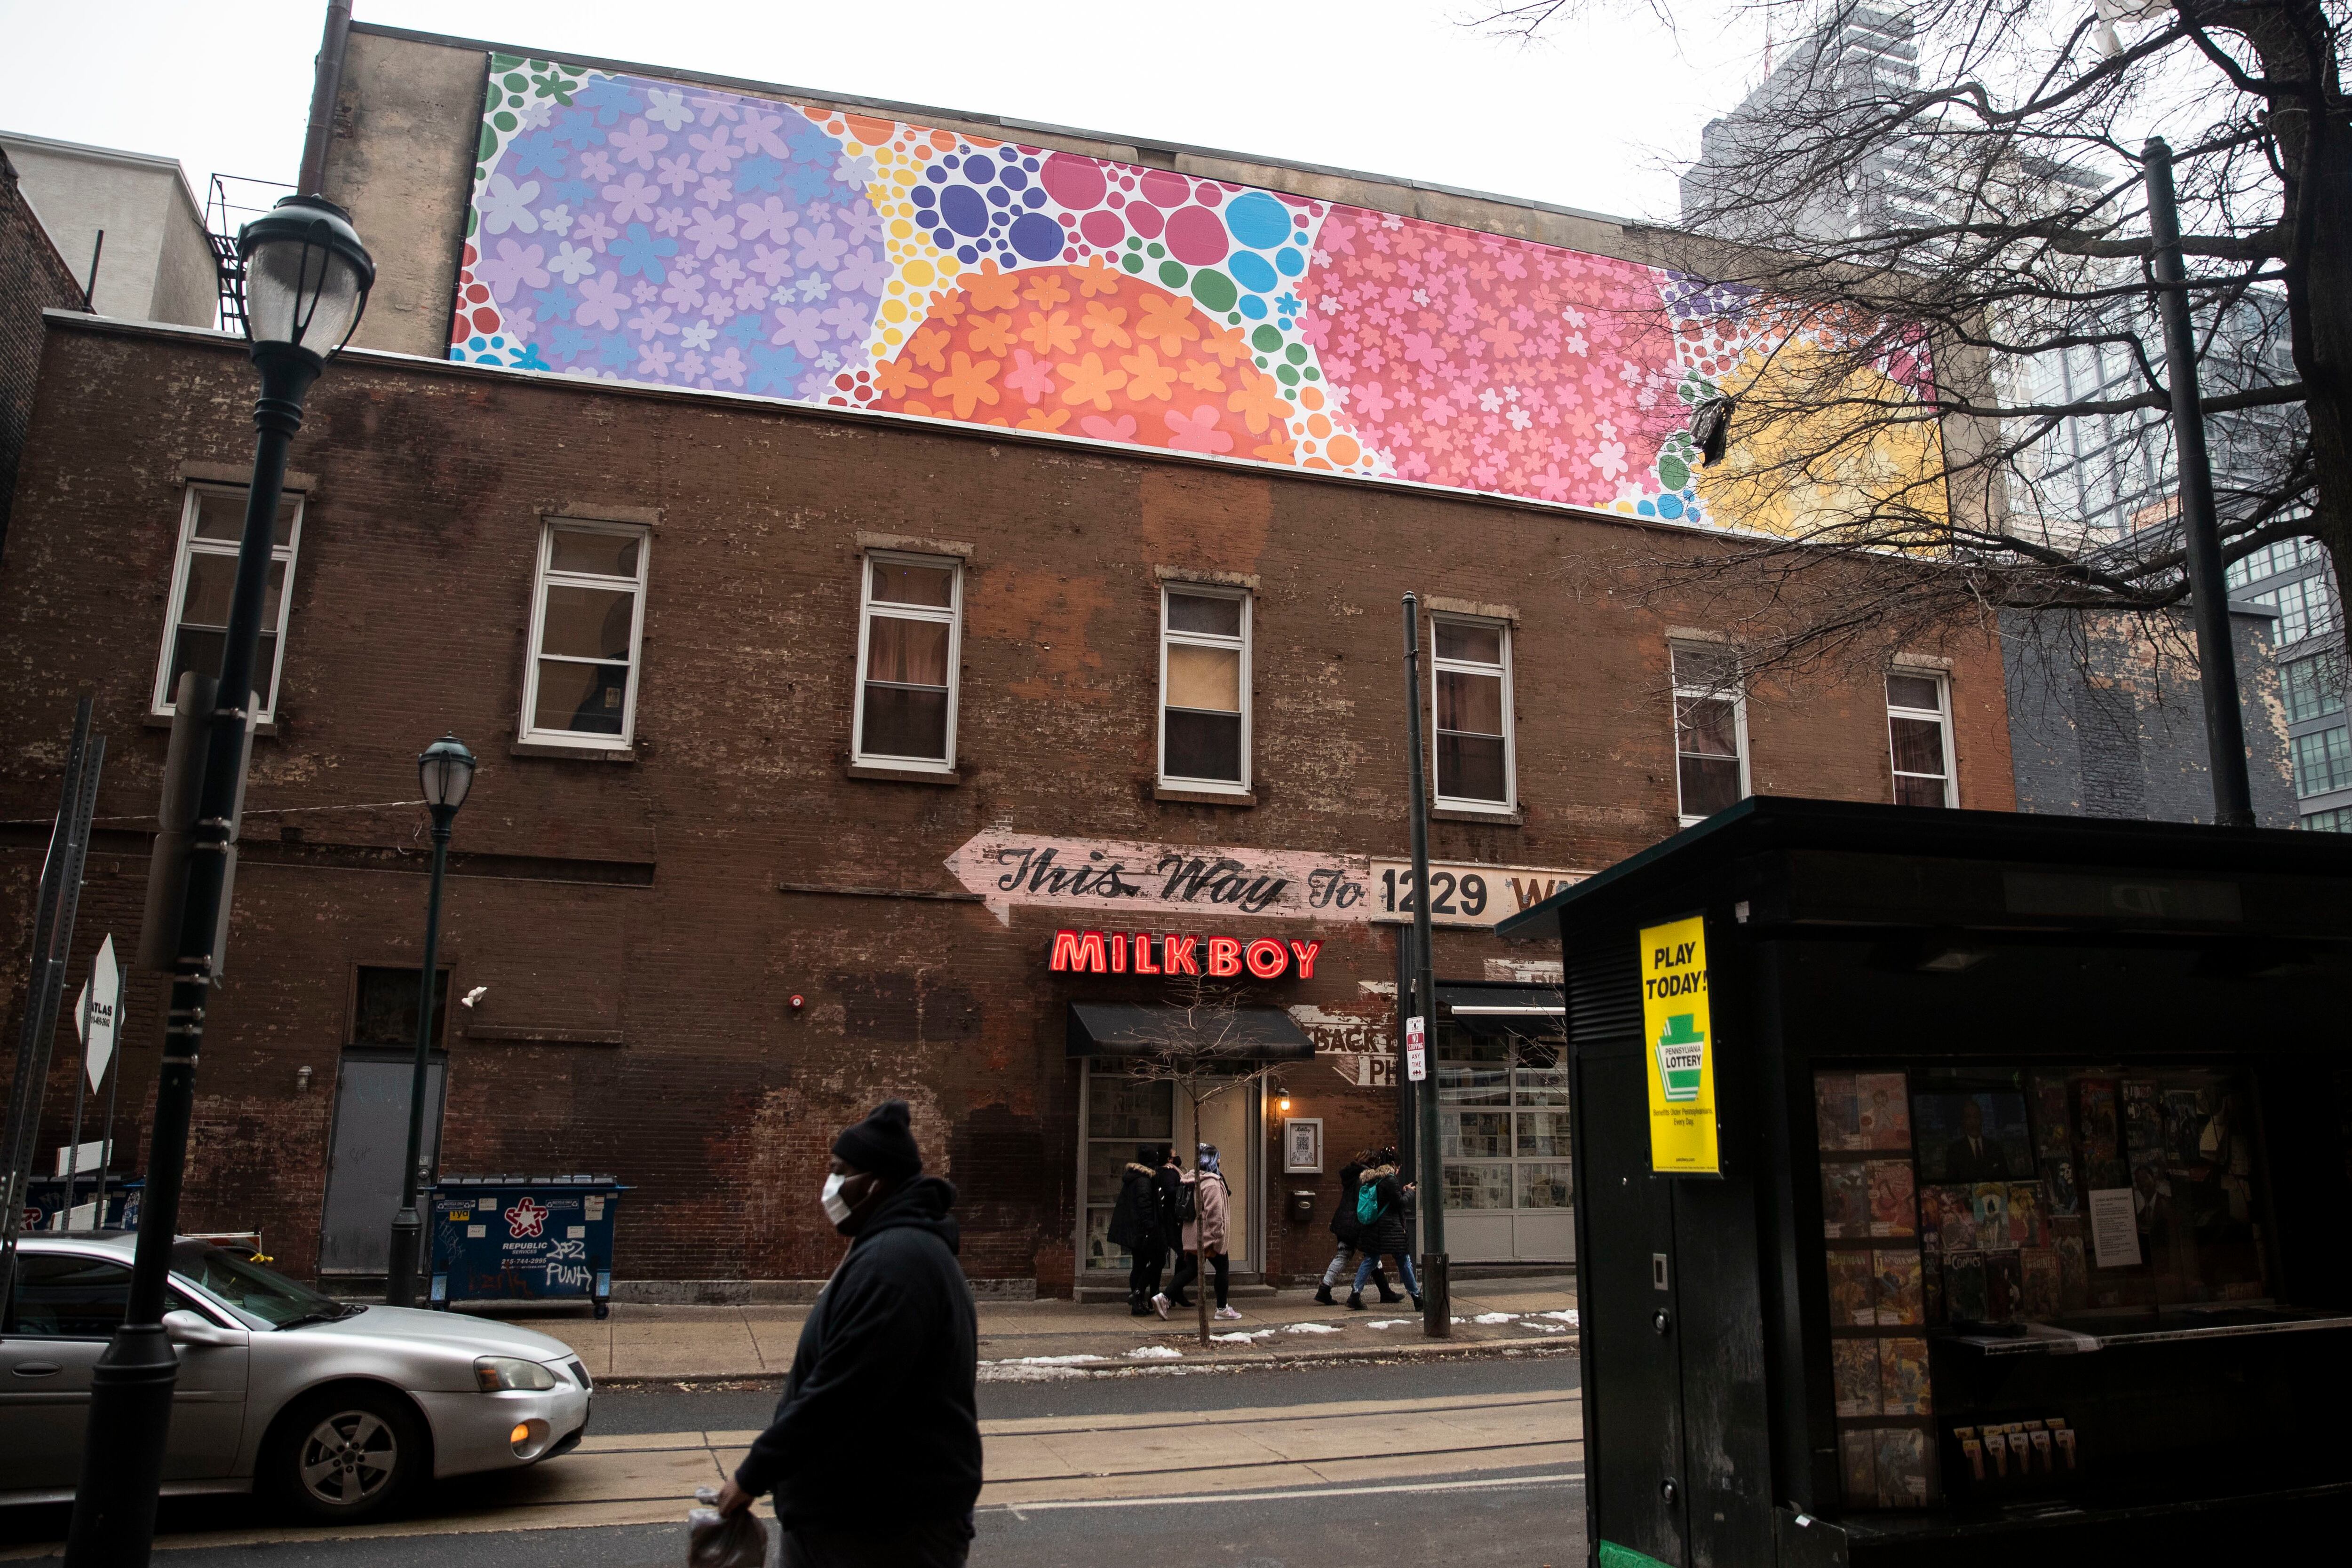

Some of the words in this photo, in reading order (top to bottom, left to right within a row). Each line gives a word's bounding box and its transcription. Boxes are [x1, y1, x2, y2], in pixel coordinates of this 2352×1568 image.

[997, 848, 1140, 897] This
[1157, 855, 1288, 912] Way
[1308, 868, 1366, 909] To
[1382, 869, 1487, 916] 1229
[1654, 942, 1696, 969] PLAY
[1646, 970, 1708, 999] TODAY!
[1314, 1027, 1381, 1053] BACK
[1412, 1034, 1419, 1043] NO
[1665, 1045, 1701, 1055] PENNSYLVANIA
[1666, 1054, 1701, 1068] LOTTERY
